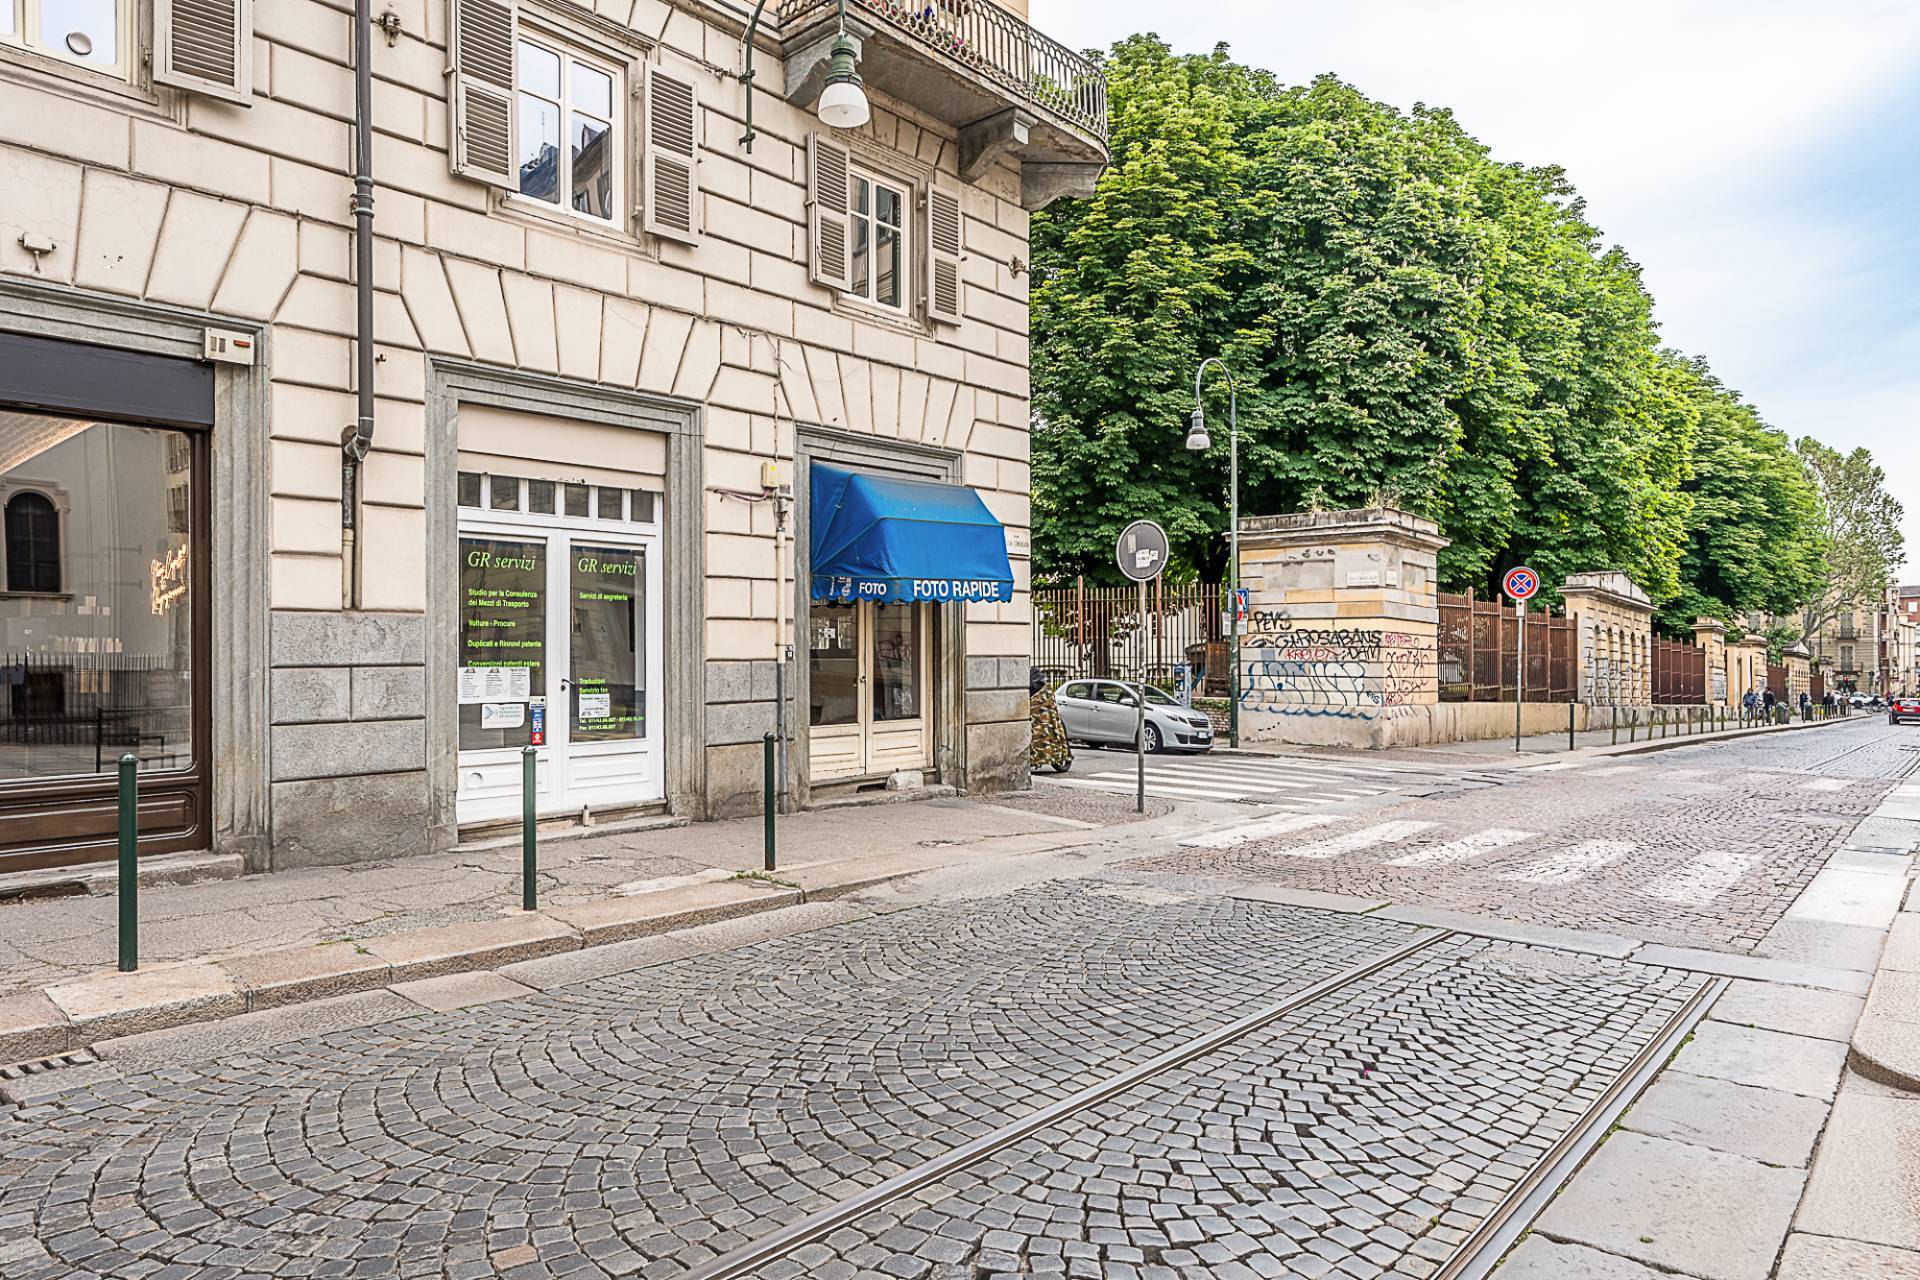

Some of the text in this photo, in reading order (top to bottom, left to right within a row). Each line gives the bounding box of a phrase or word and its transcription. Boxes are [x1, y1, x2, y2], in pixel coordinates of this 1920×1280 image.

[467, 551, 536, 571] GR servizi
[578, 557, 638, 576] GR servizi
[468, 588, 487, 596] Studio
[505, 590, 538, 598] Consulenza
[859, 582, 887, 595] FOTO
[913, 580, 1000, 598] FOTO RAPIDE
[502, 600, 530, 608] Trasporto
[467, 619, 489, 627] Volture
[467, 640, 494, 648] Duplicati
